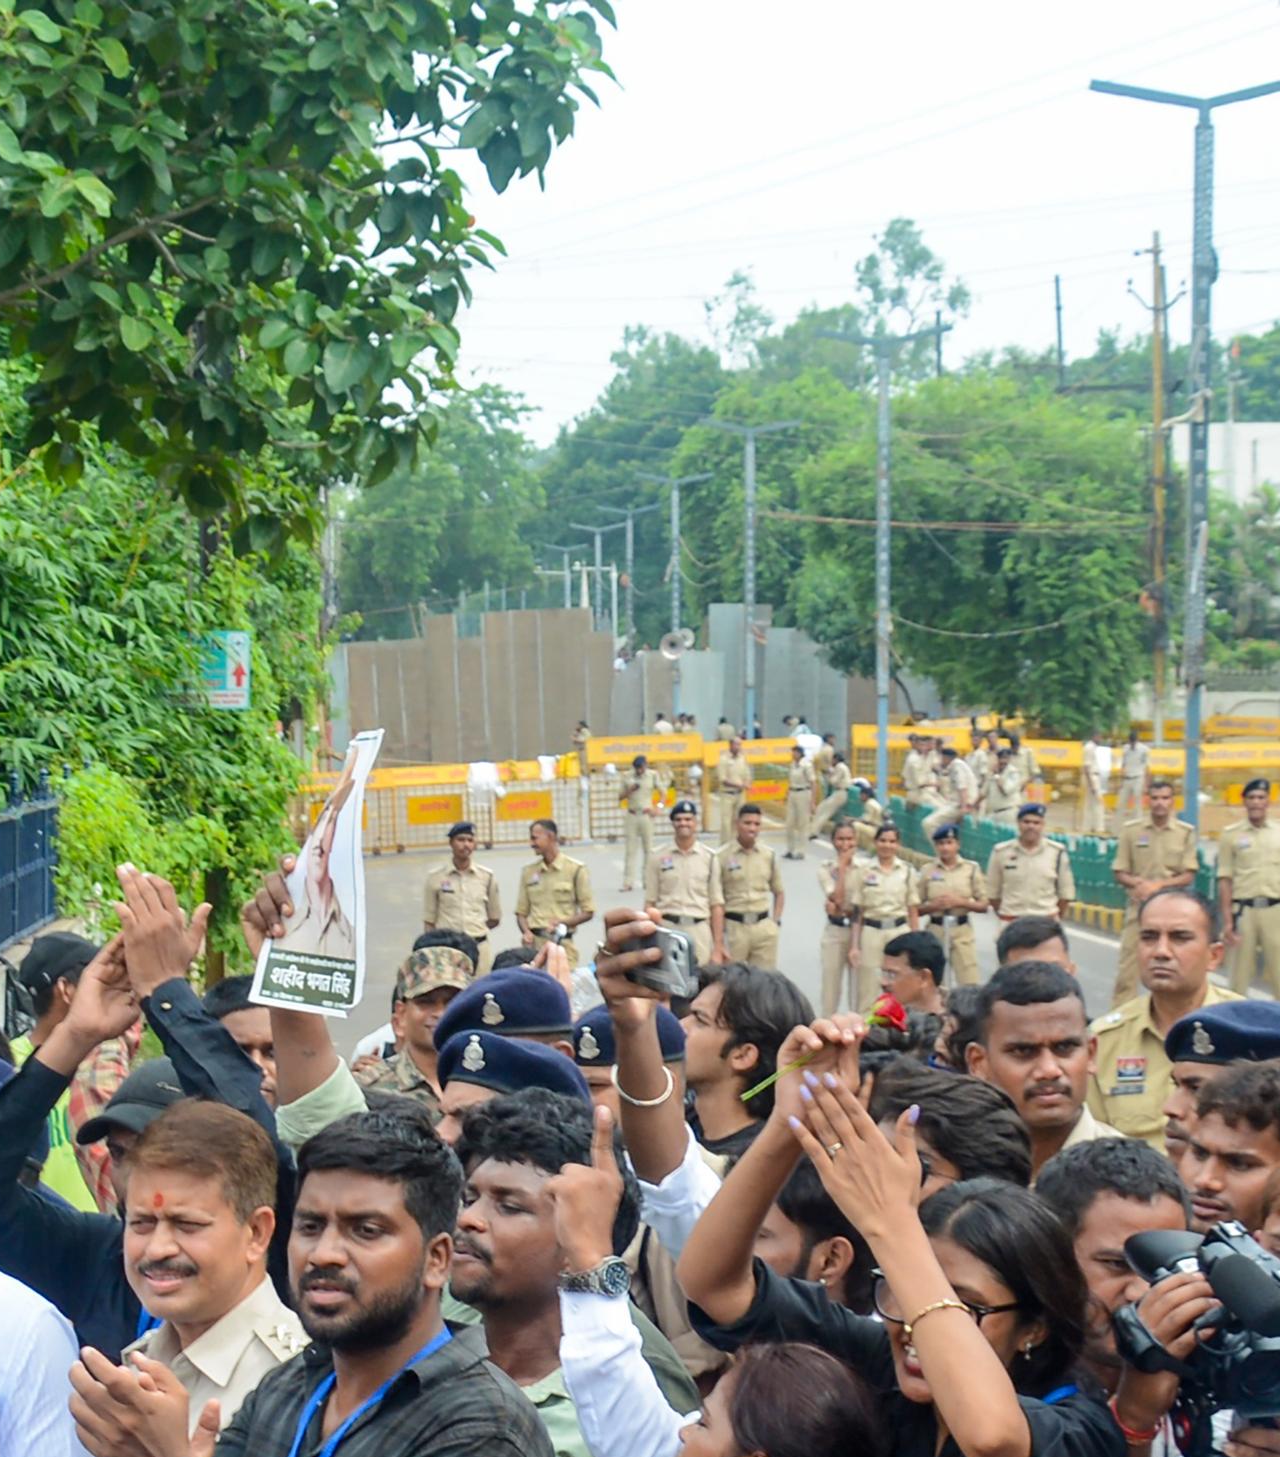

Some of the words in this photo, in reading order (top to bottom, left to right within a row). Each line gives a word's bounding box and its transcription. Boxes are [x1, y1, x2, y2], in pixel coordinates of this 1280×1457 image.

[270, 964, 307, 990] शहीद
[307, 972, 331, 992] भगत
[331, 971, 351, 998] सिंह
